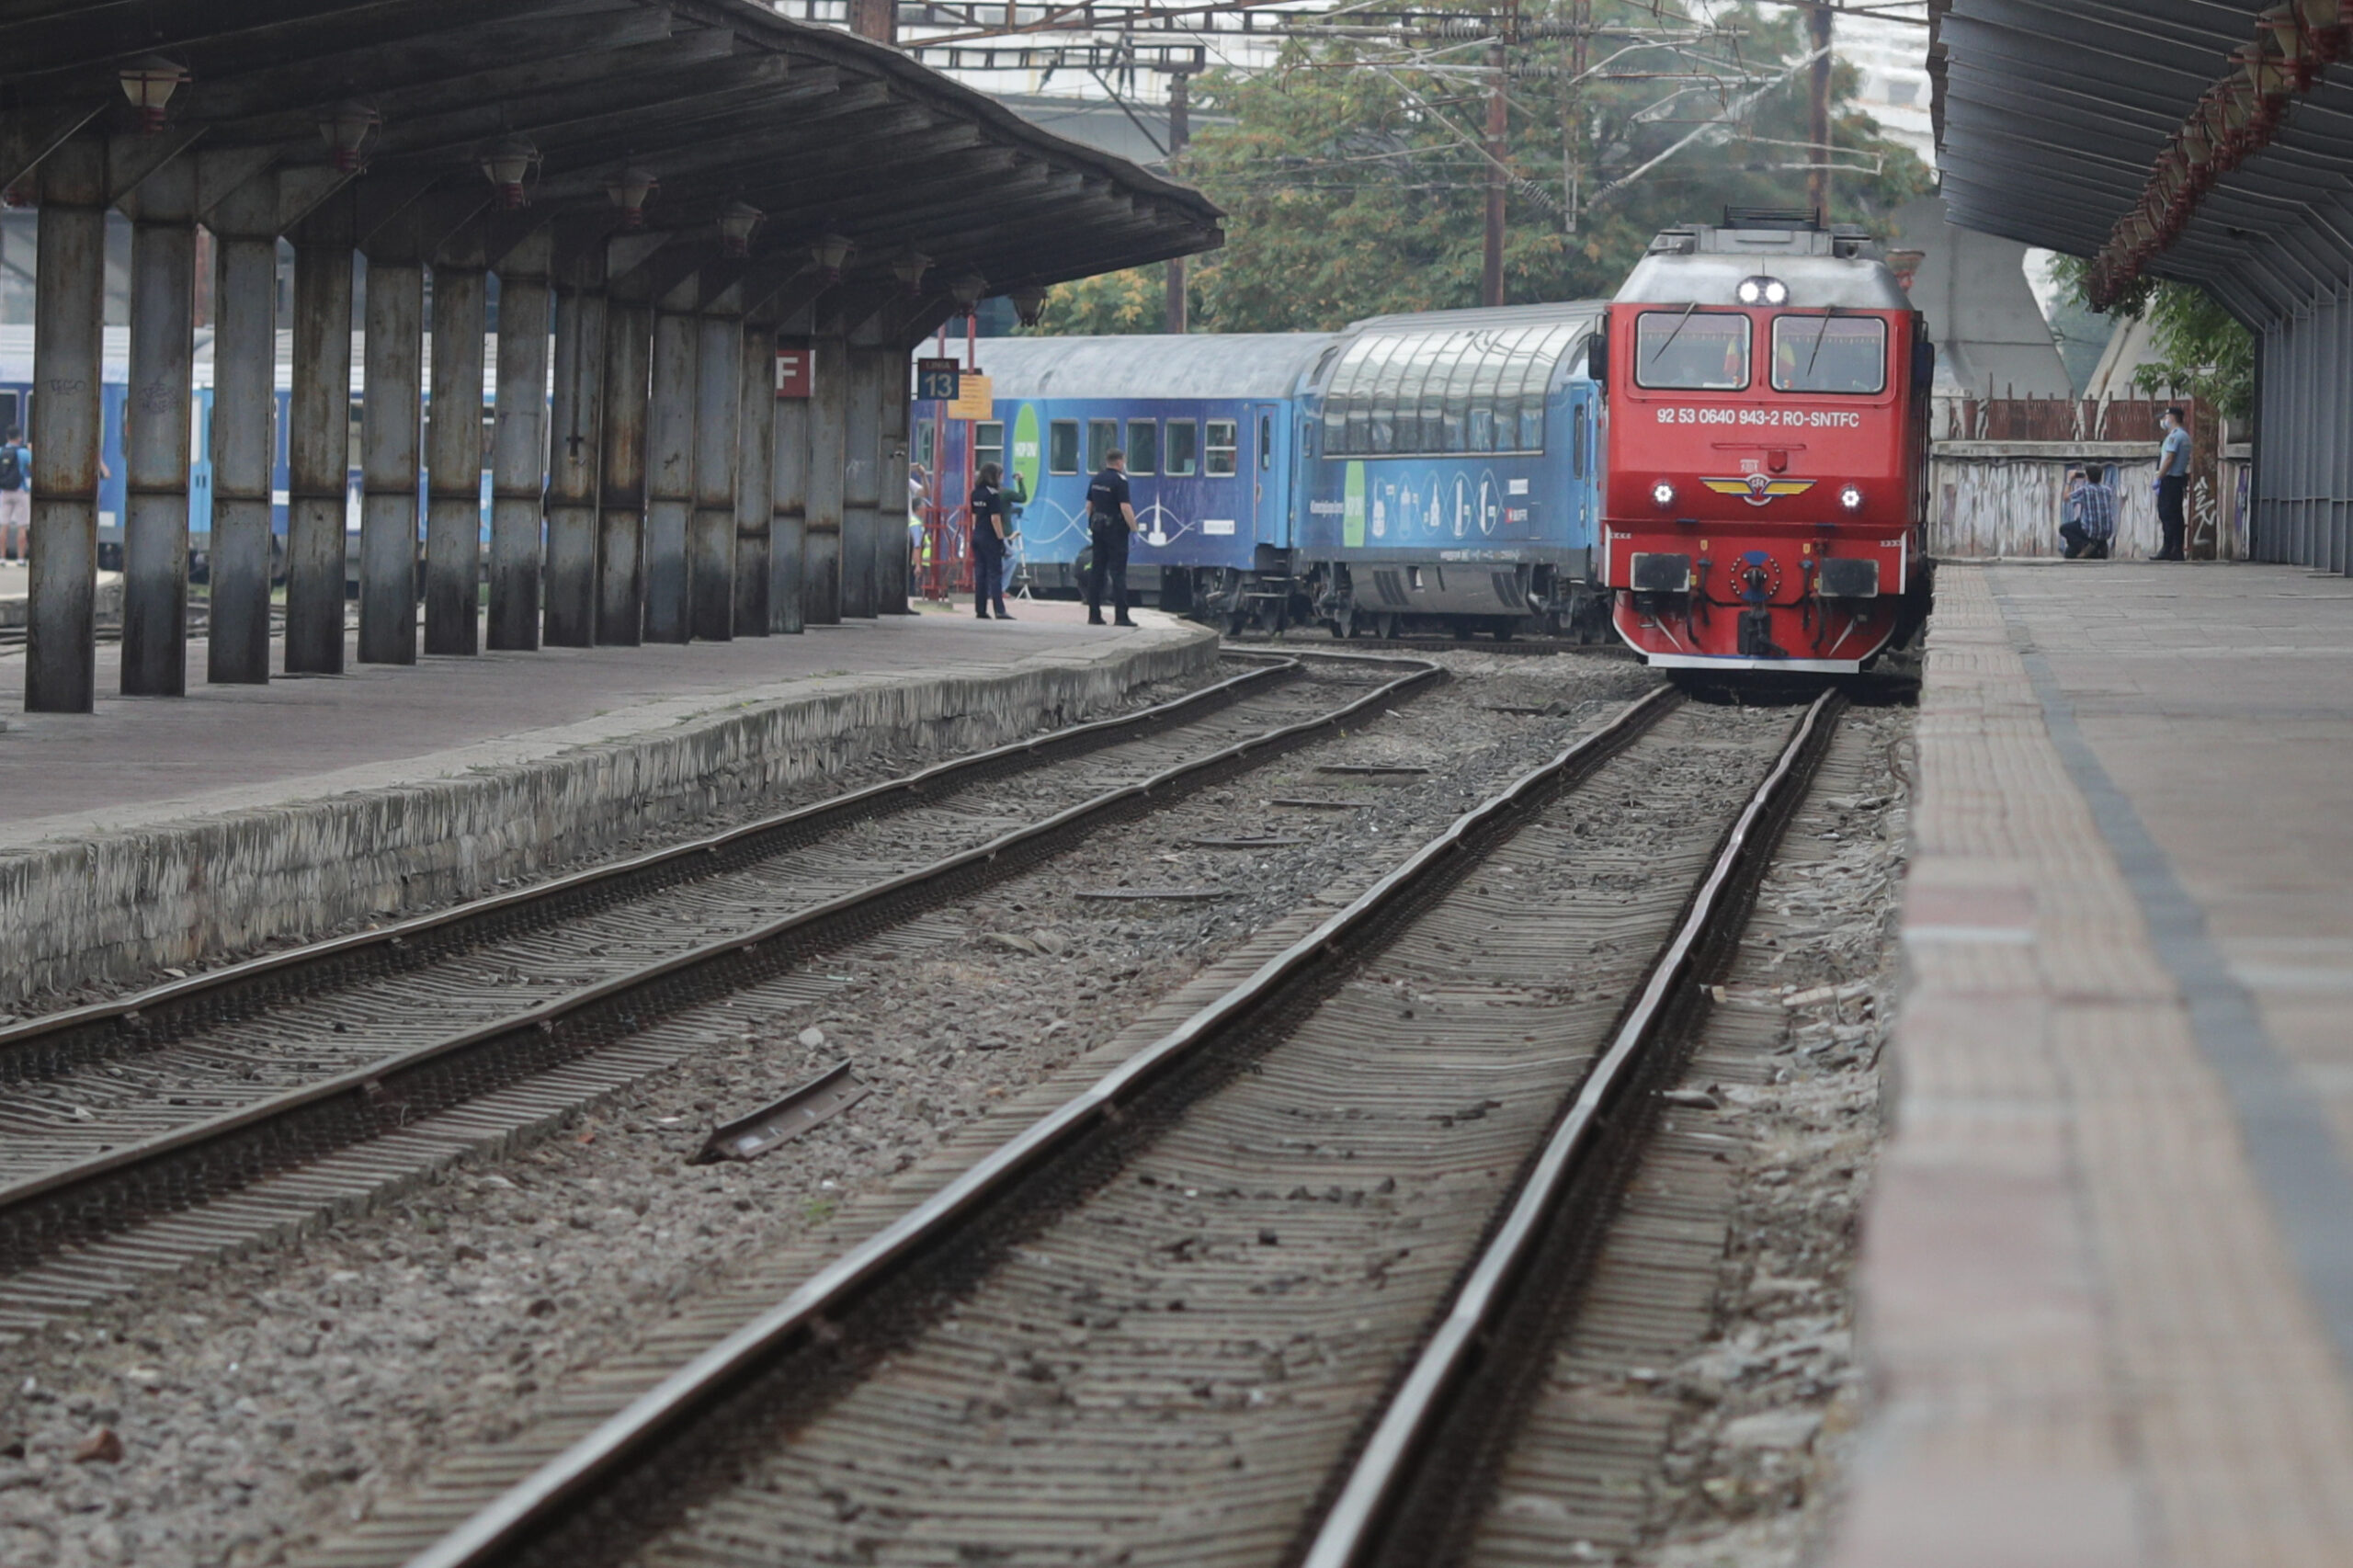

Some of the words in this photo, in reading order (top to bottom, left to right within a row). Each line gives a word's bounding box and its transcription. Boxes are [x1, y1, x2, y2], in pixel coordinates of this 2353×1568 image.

[776, 357, 799, 390] F
[925, 373, 952, 398] 13
[1657, 408, 1675, 424] 92
[1678, 408, 1695, 424] 53
[1699, 409, 1735, 425] 0640
[1739, 410, 1779, 426] 943-2
[1783, 411, 1859, 427] RO-SNTFC
